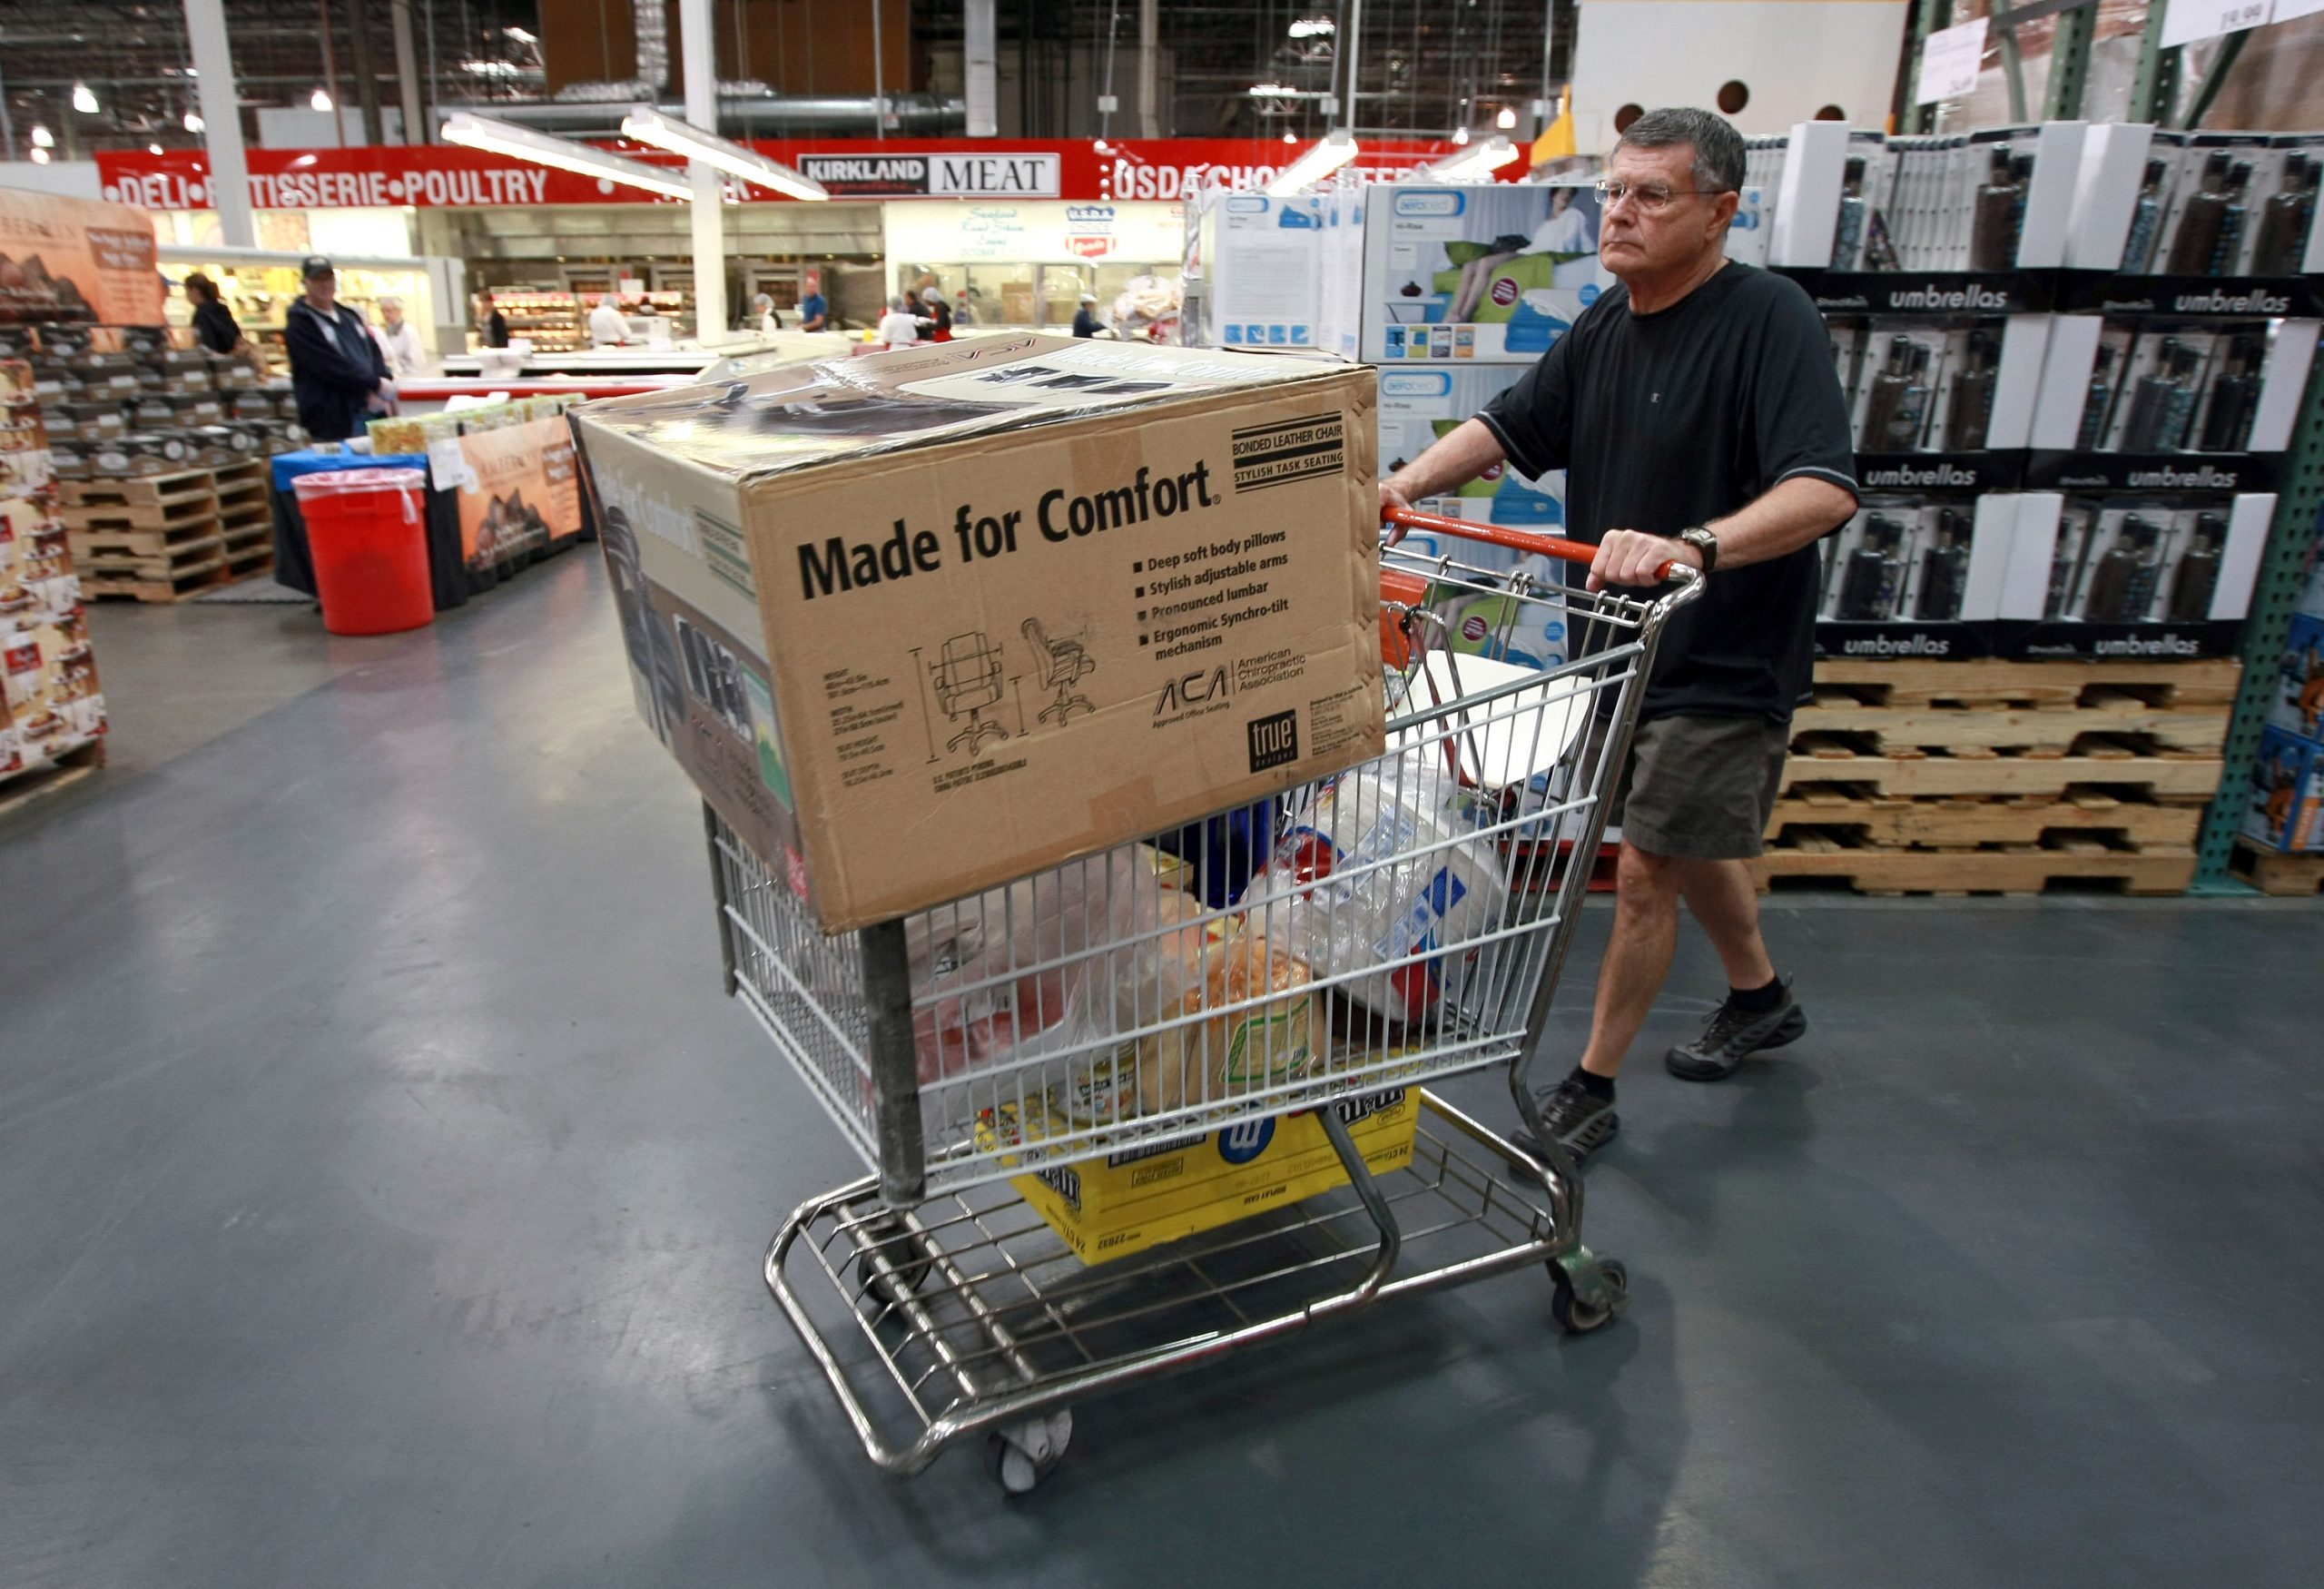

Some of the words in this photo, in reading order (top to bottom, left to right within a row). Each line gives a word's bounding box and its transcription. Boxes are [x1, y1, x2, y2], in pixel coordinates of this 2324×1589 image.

[404, 169, 547, 205] POULTRY
[807, 159, 925, 181] KIRKLAND
[941, 159, 1047, 192] MEAT
[1889, 284, 2007, 308] umbrellas
[2175, 289, 2290, 312] umbrellas
[1233, 438, 1271, 456] BONDED
[1273, 429, 1314, 449] LEATHER
[1315, 424, 1343, 439] CHAIR
[1235, 465, 1273, 482] STYLISH
[1276, 460, 1301, 474] TASK
[1304, 451, 1344, 469] SEATING
[1866, 464, 1976, 486] umbrellas
[2128, 465, 2238, 488] umbrellas
[797, 518, 940, 600] Made
[954, 504, 1021, 563] for
[1037, 459, 1213, 544] Comfort
[1148, 555, 1180, 571] Deep
[1184, 546, 1208, 563] soft
[1210, 538, 1241, 557] body
[1244, 530, 1286, 553] pillows
[1150, 575, 1191, 596] Stylish
[1194, 559, 1256, 585] adjustable
[1259, 554, 1288, 569] arms
[1152, 589, 1224, 619] Pronounced
[1226, 581, 1268, 601] lumbar
[1154, 617, 1218, 644] Ergonomic
[1220, 597, 1289, 627] Synchro-tilt
[1156, 634, 1223, 661] mechanism
[1237, 647, 1291, 670] American
[1845, 633, 1950, 655] umbrellas
[2095, 634, 2201, 655] umbrellas
[1238, 653, 1306, 681] Chiropractic
[1239, 666, 1305, 692] Association
[1153, 664, 1229, 717] ACA
[1152, 715, 1185, 729] Approved
[1185, 707, 1206, 720] Office
[1206, 700, 1231, 715] Seating
[1252, 718, 1292, 757] true
